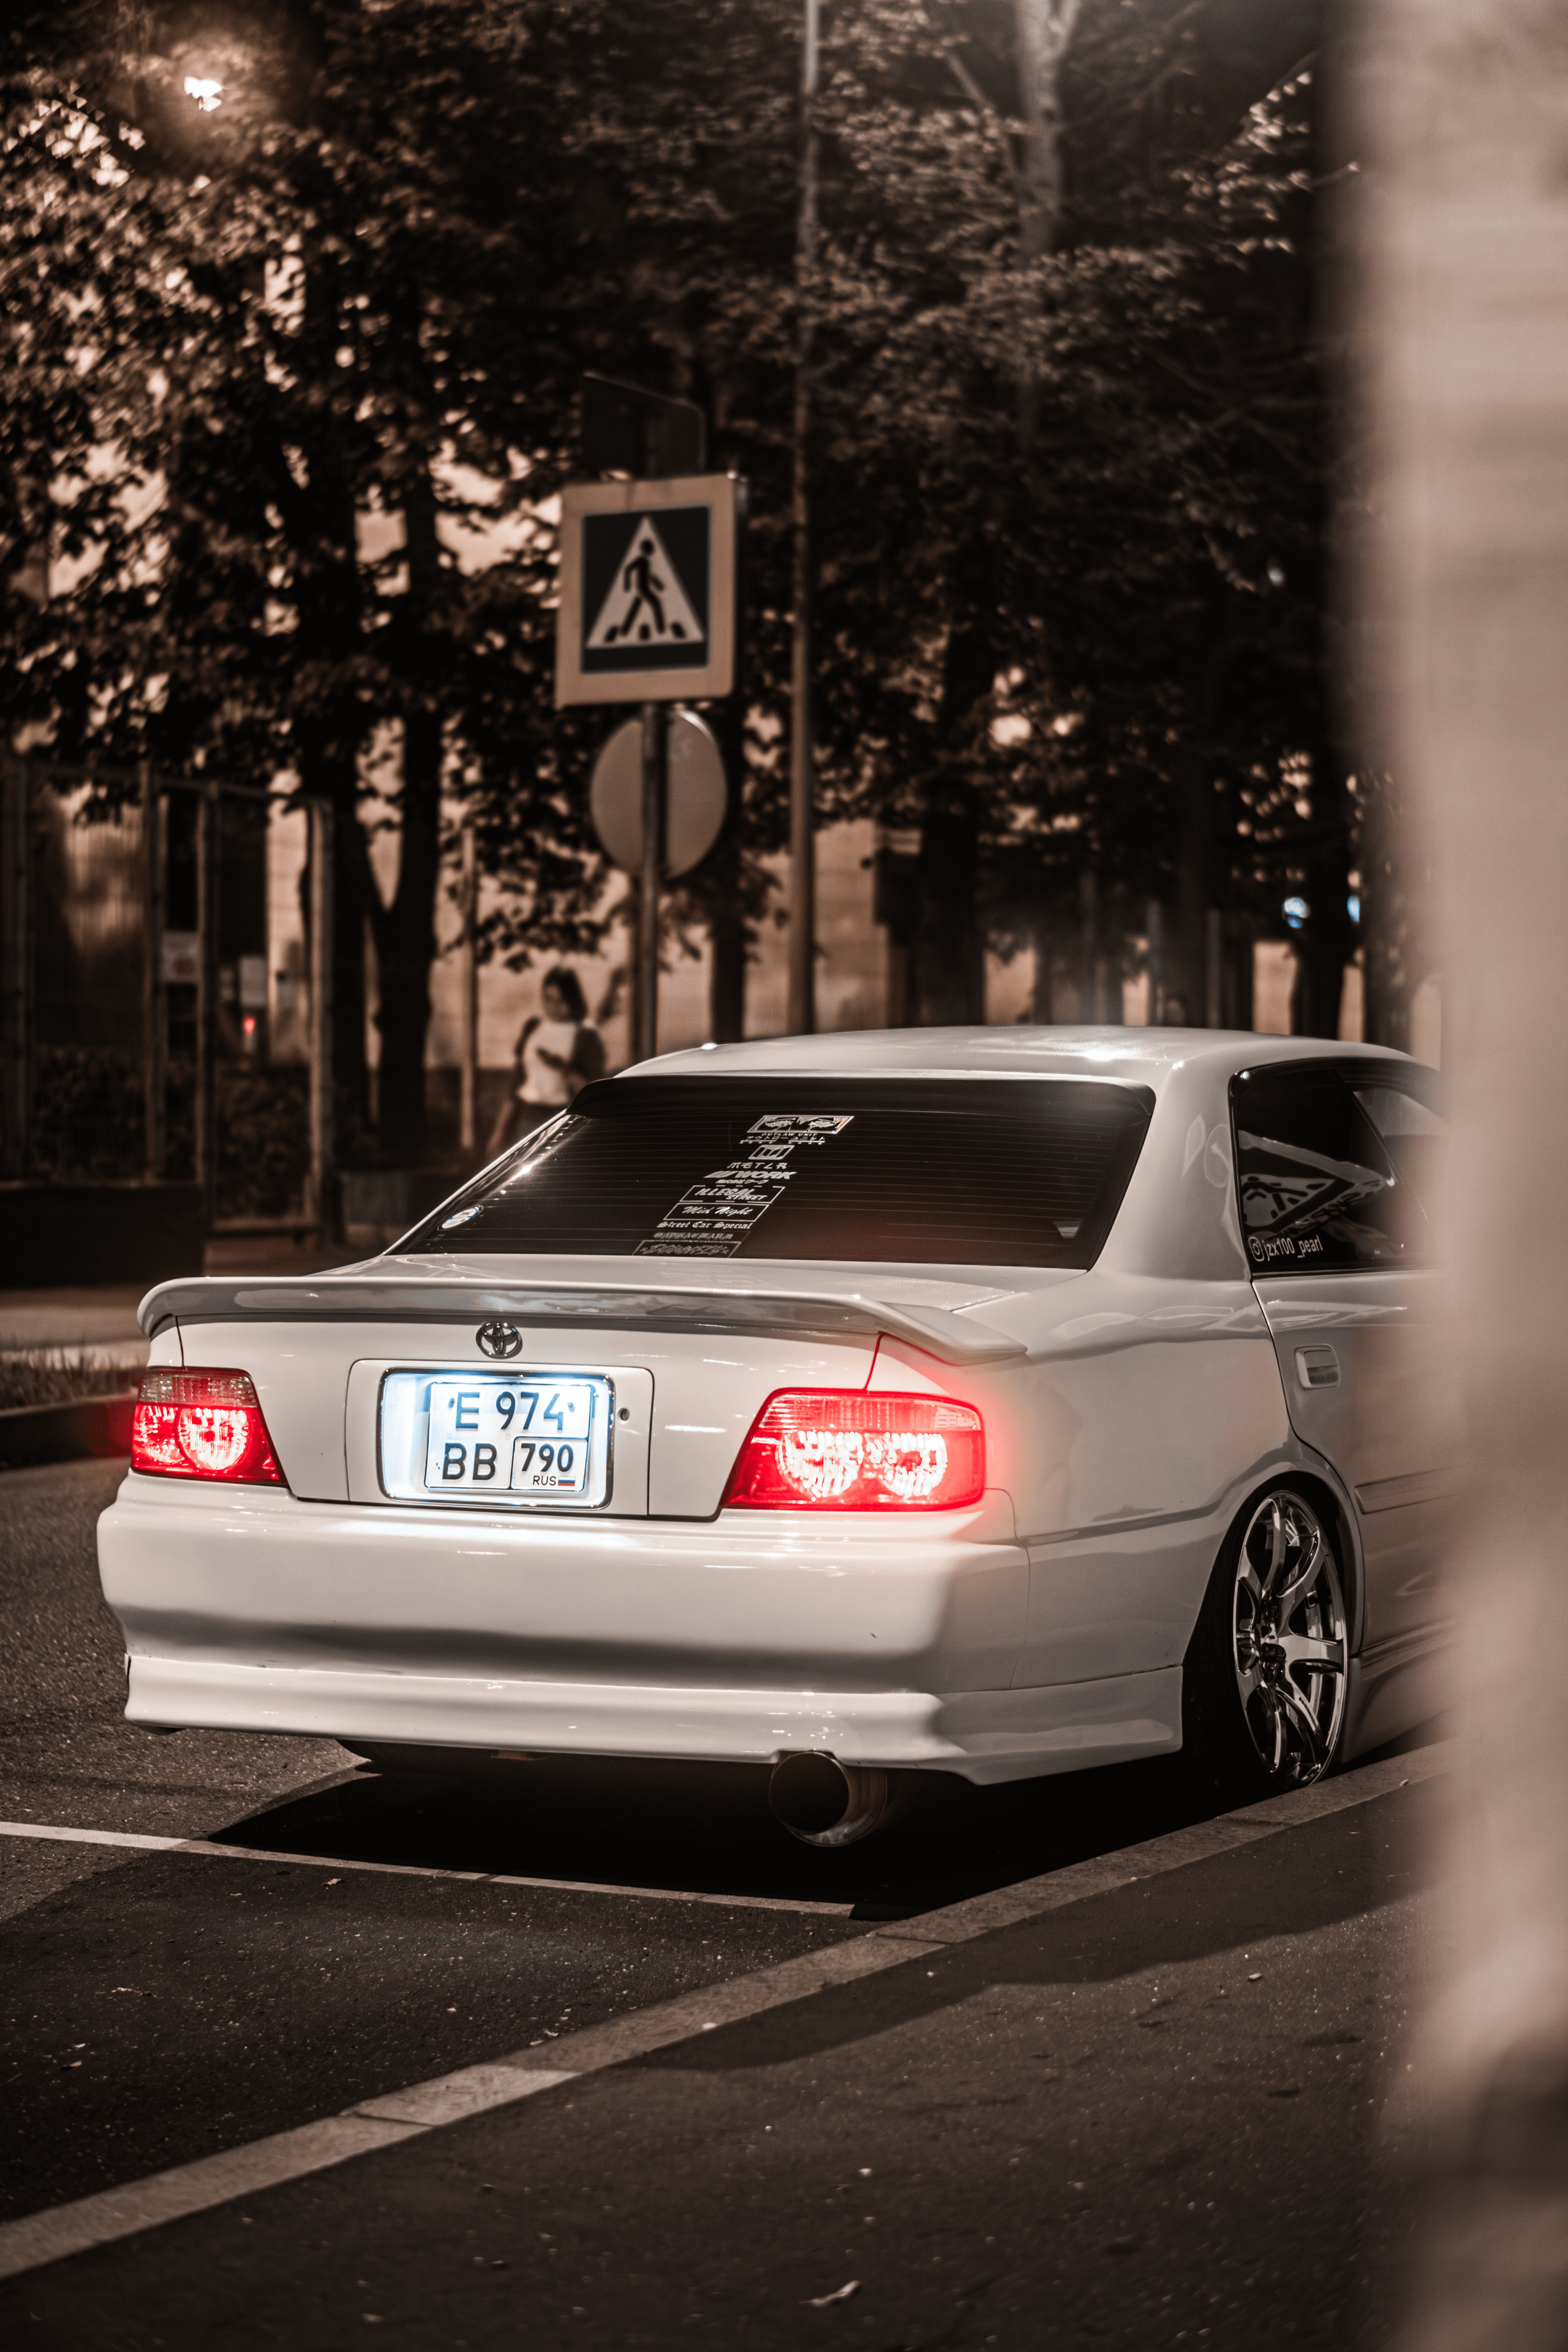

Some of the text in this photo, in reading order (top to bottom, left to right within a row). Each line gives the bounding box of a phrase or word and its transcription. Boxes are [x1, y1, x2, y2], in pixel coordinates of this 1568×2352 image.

[734, 1170, 797, 1180] WORK
[715, 1206, 753, 1216] Night
[455, 1391, 564, 1431] E 974
[442, 1442, 573, 1481] BB 790
[532, 1475, 556, 1485] RUS
